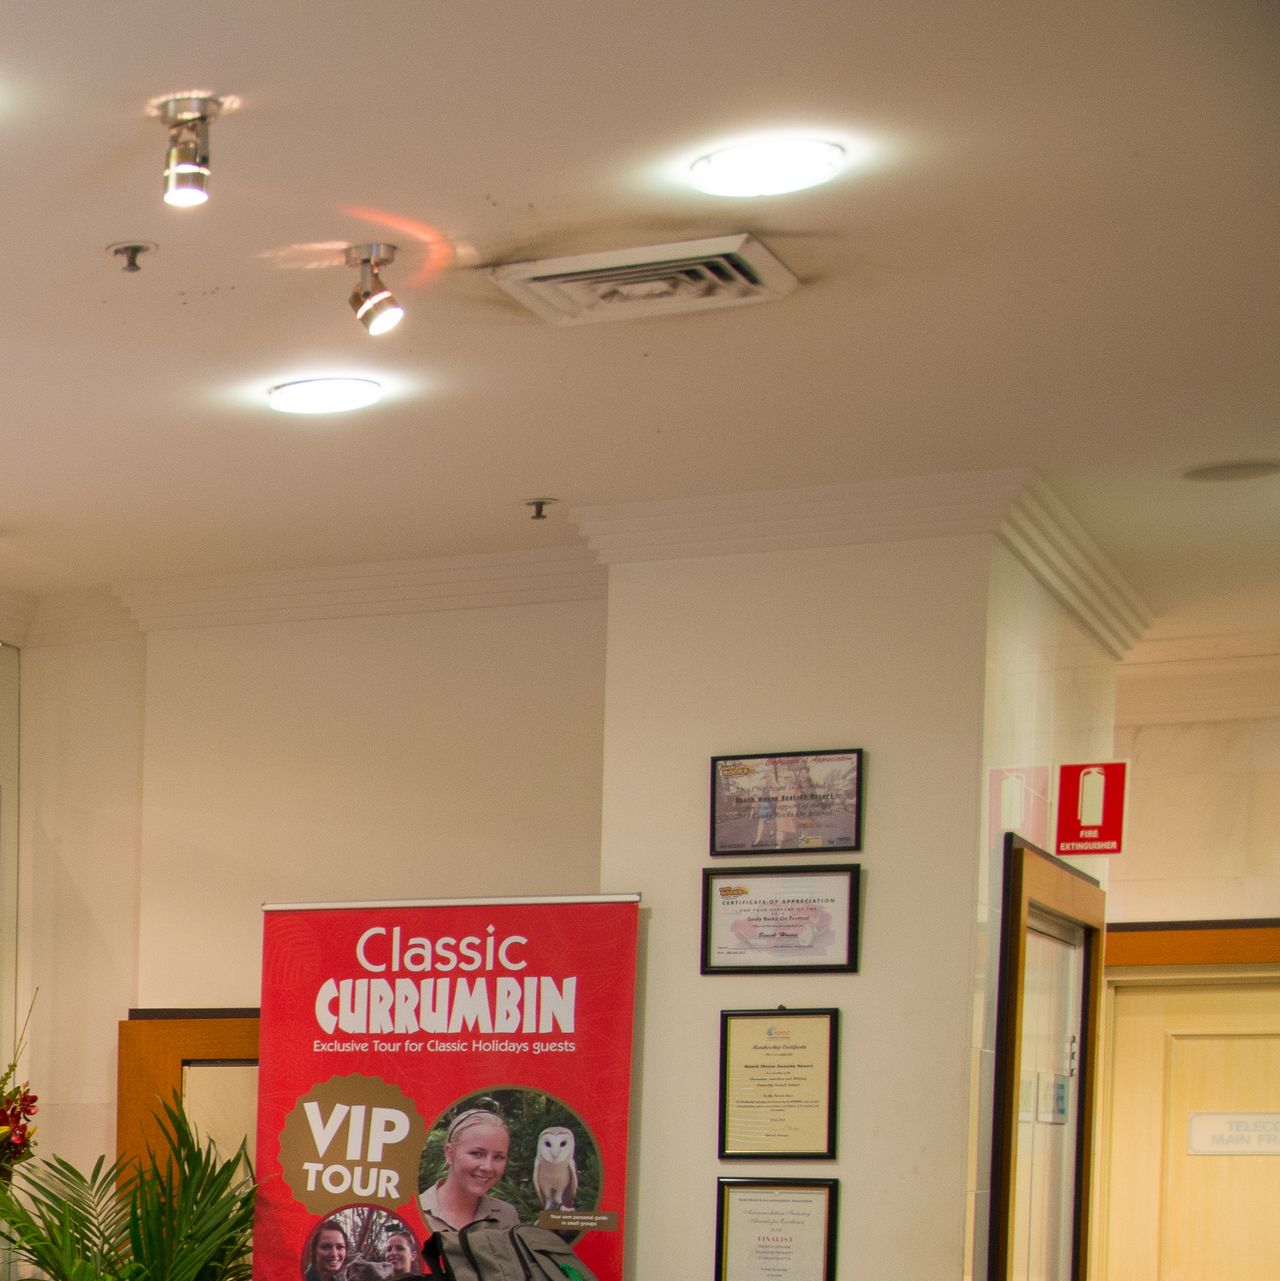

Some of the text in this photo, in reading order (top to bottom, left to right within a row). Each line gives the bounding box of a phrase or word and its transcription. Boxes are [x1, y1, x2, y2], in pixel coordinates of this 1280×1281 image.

[1060, 841, 1117, 850] EXTINGUISHER
[1080, 830, 1098, 838] FIRE
[356, 925, 528, 972] Classic
[315, 976, 577, 1034] CURRUMBIN
[314, 1040, 575, 1054] Exclusive Tour for Classic Holidays guests
[303, 1101, 410, 1162] VIP
[1211, 1134, 1250, 1144] MAIN
[303, 1162, 400, 1199] TOUR
